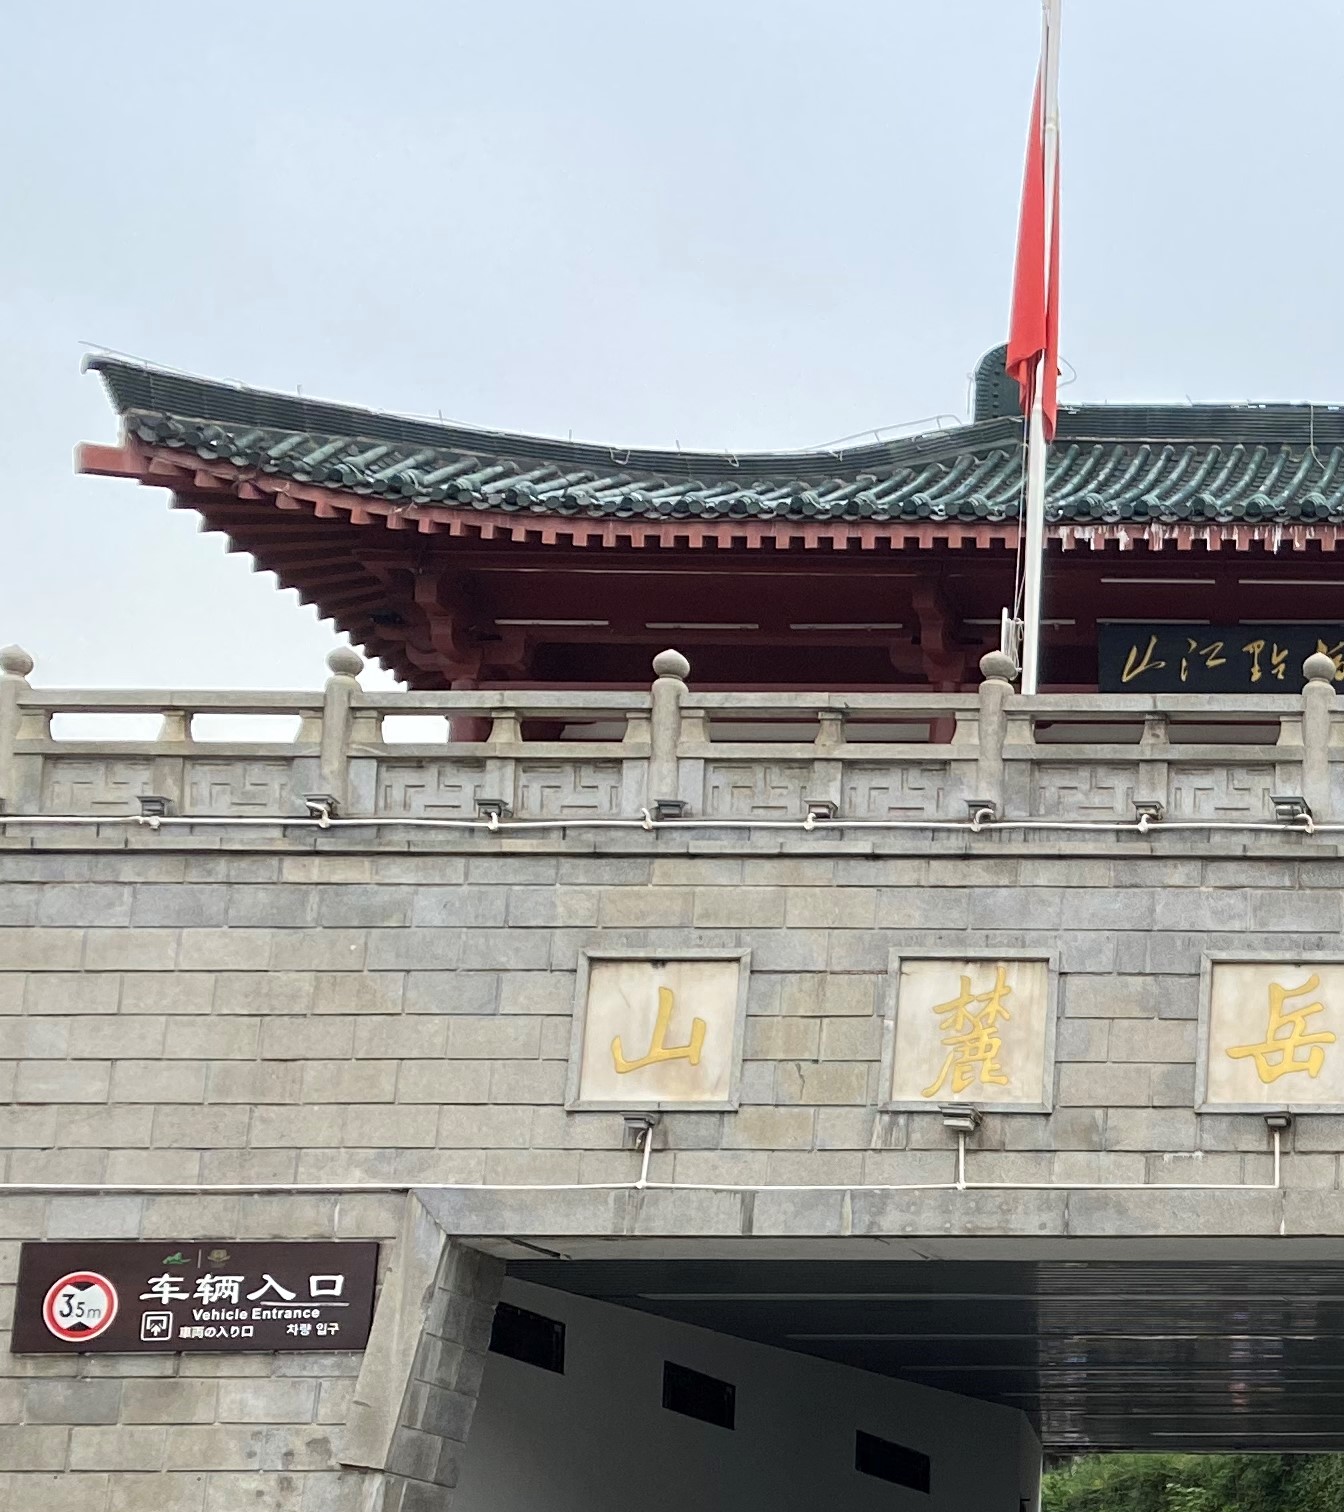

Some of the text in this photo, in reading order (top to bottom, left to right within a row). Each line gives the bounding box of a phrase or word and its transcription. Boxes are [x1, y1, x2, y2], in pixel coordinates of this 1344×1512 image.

[139, 1273, 345, 1304] 车辆入口
[192, 1307, 321, 1321] Vehicle Entrance
[286, 1323, 341, 1337] 차량 입구
